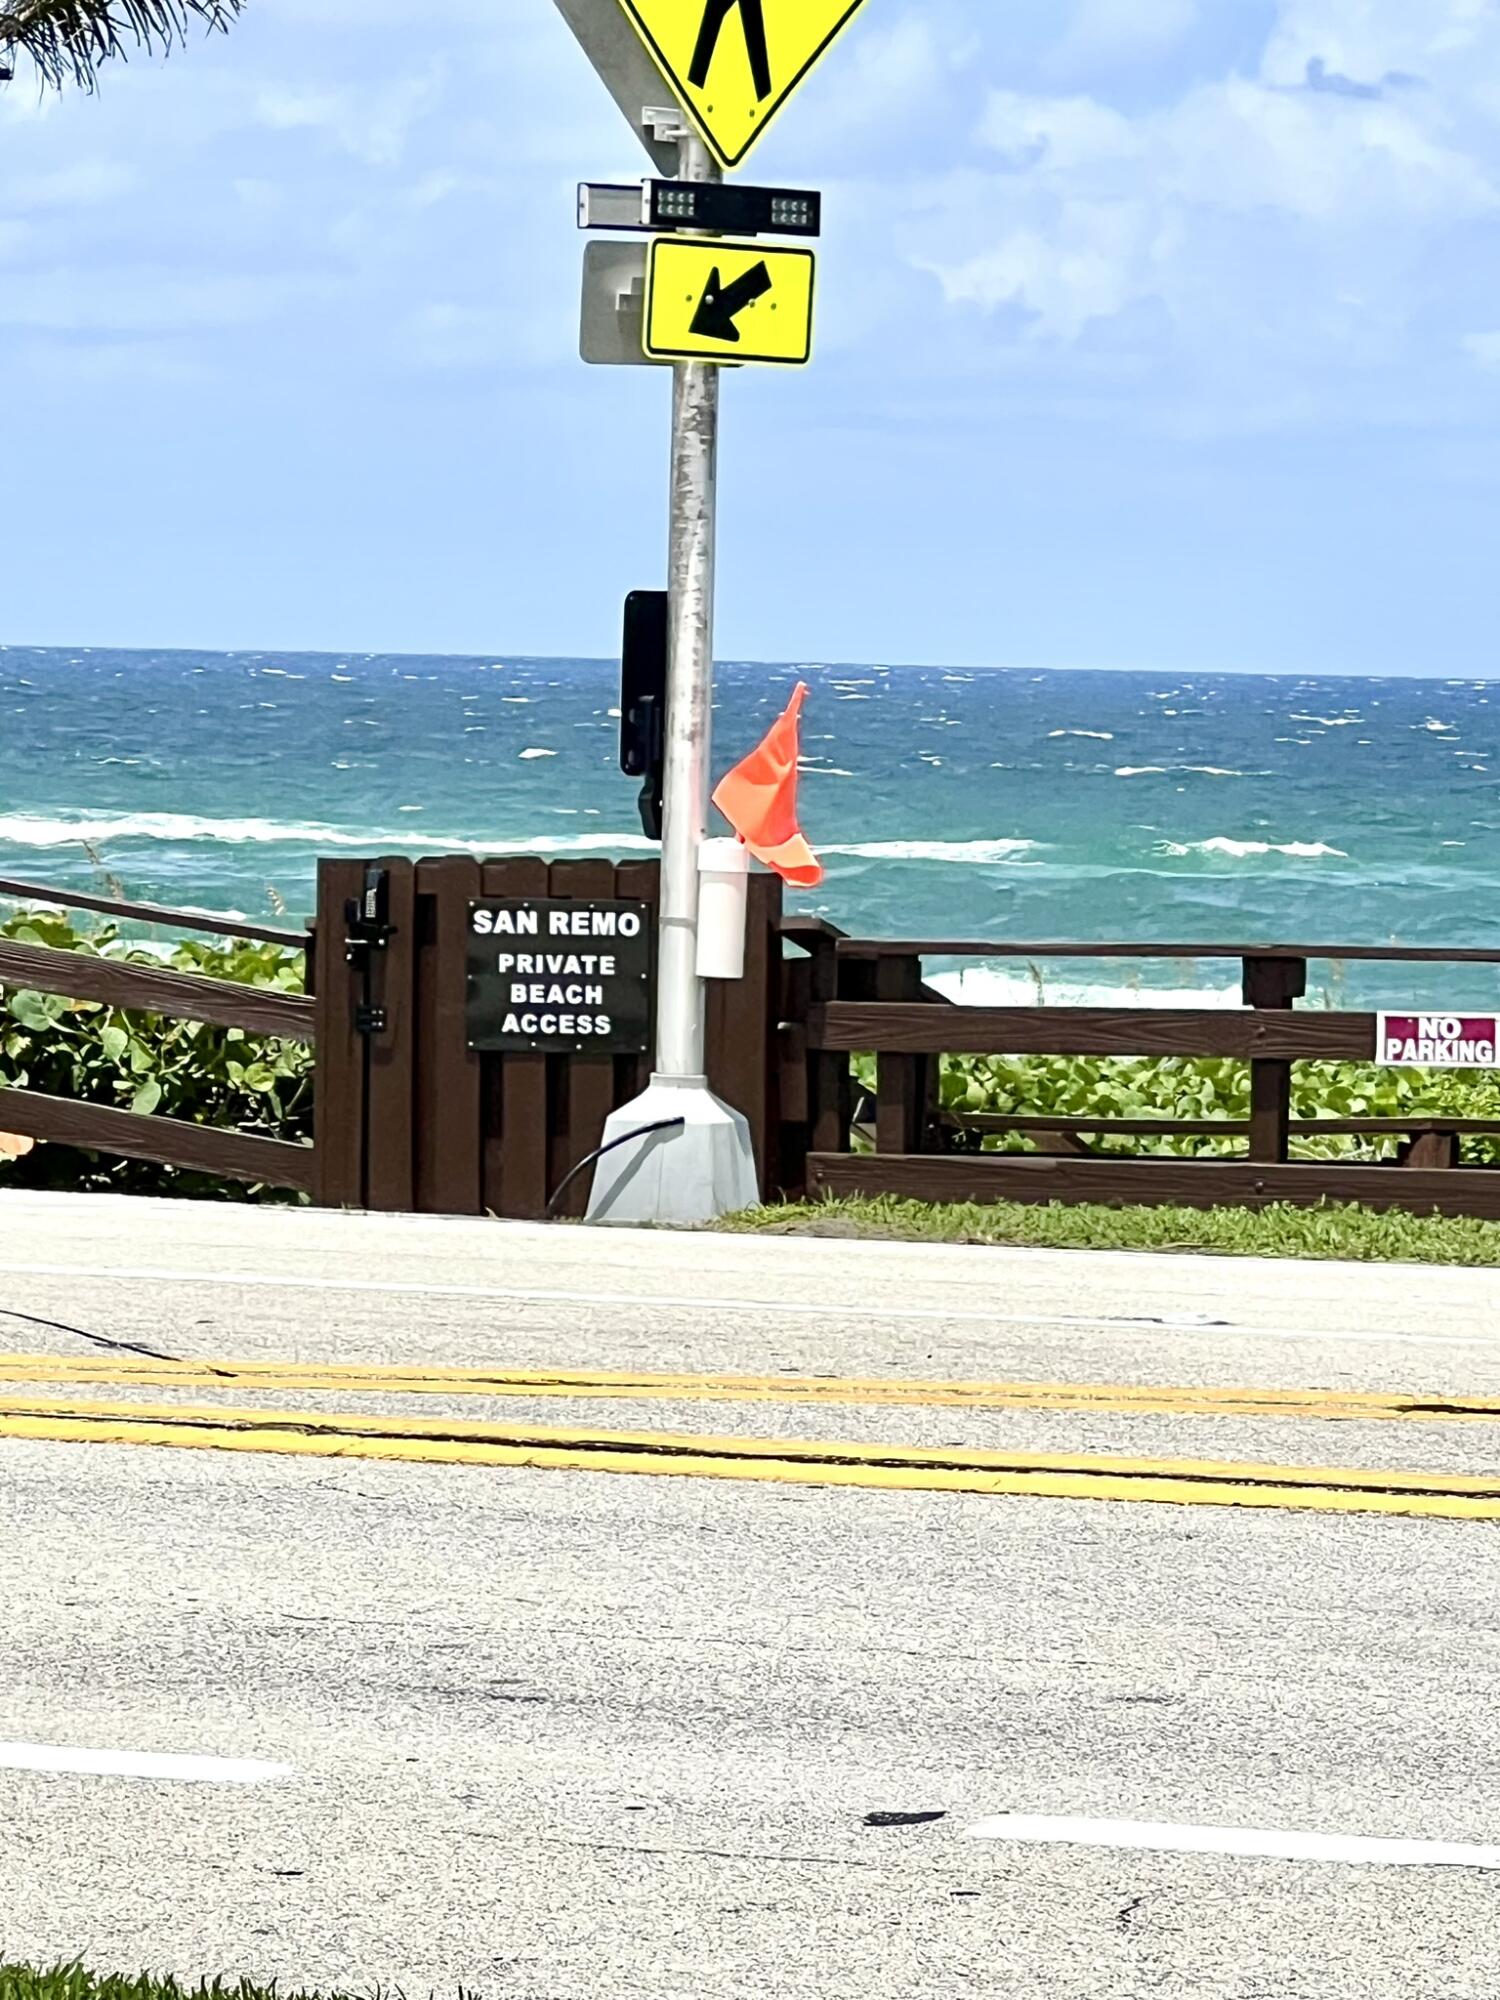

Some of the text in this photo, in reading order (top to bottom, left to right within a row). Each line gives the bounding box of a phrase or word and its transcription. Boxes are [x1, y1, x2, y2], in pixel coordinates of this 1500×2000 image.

[473, 910, 640, 937] SAN REMO
[498, 953, 616, 975] PRIVATE
[510, 983, 603, 1004] BEACH
[501, 1013, 611, 1034] ACCESS
[1418, 1017, 1462, 1039] NO
[1386, 1038, 1493, 1062] PARKING
